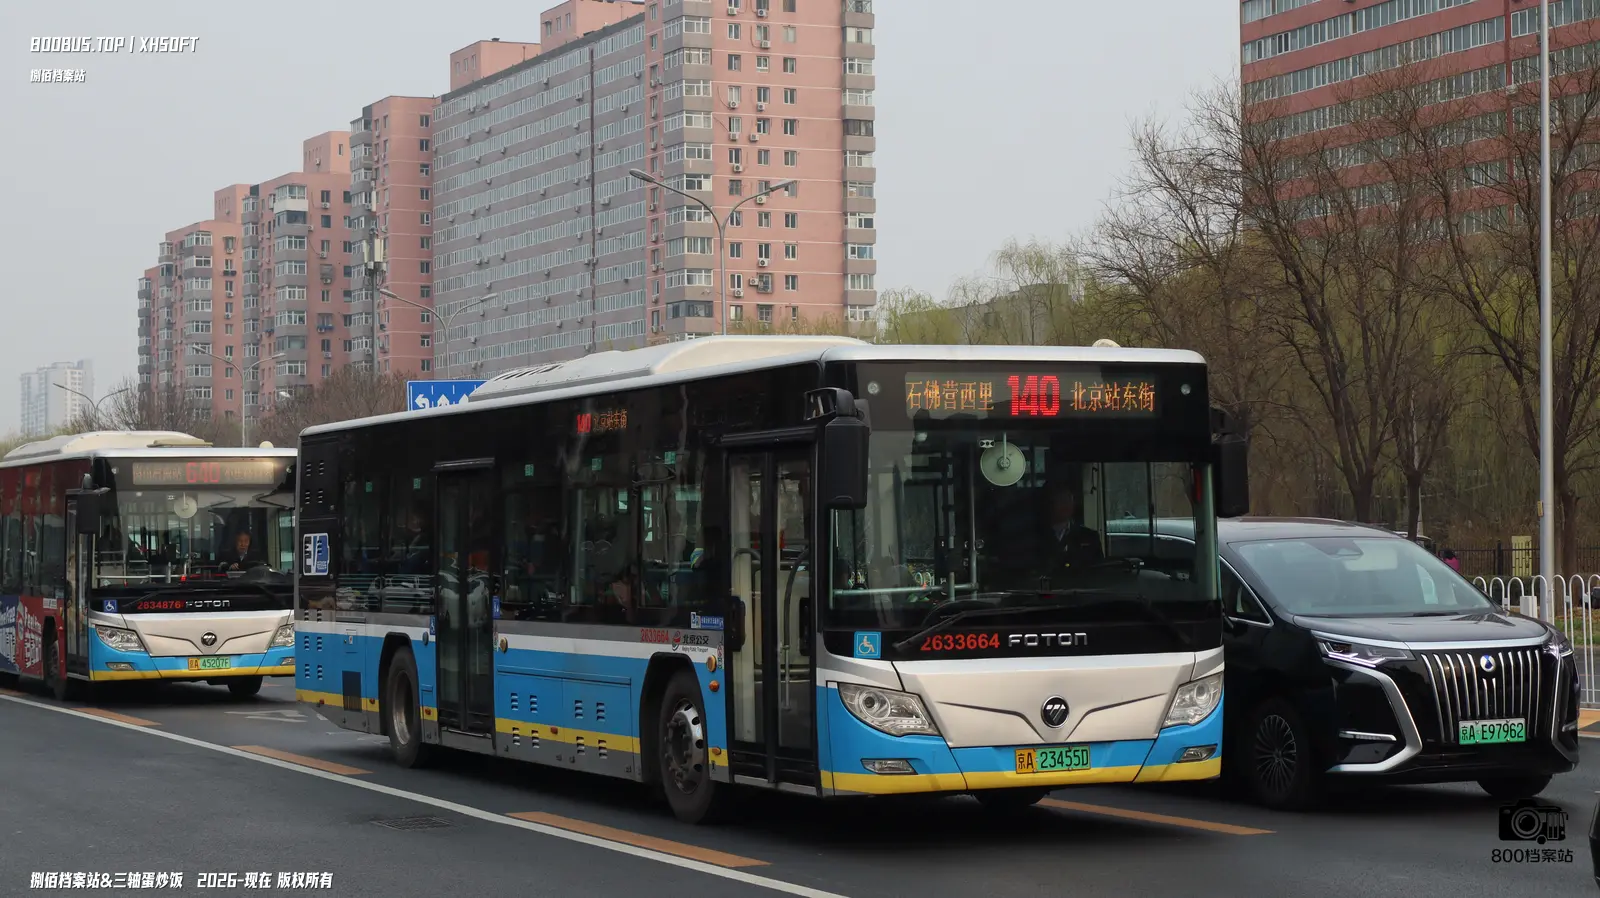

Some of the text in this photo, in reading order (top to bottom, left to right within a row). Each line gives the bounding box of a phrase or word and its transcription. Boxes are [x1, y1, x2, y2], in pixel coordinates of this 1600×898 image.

[905, 375, 1156, 416] 石佛营西里 140 北京站东街
[186, 462, 221, 483] 640
[137, 600, 181, 610] 2834876
[185, 599, 231, 608] FOTON
[640, 628, 669, 643] 2633664
[682, 634, 709, 645] 北京公交
[920, 632, 1000, 651] 2633664
[1008, 632, 1088, 647] FOTON
[202, 658, 229, 668] 45207F
[1481, 722, 1524, 740] E97962
[1017, 749, 1089, 769] 京A 23455D
